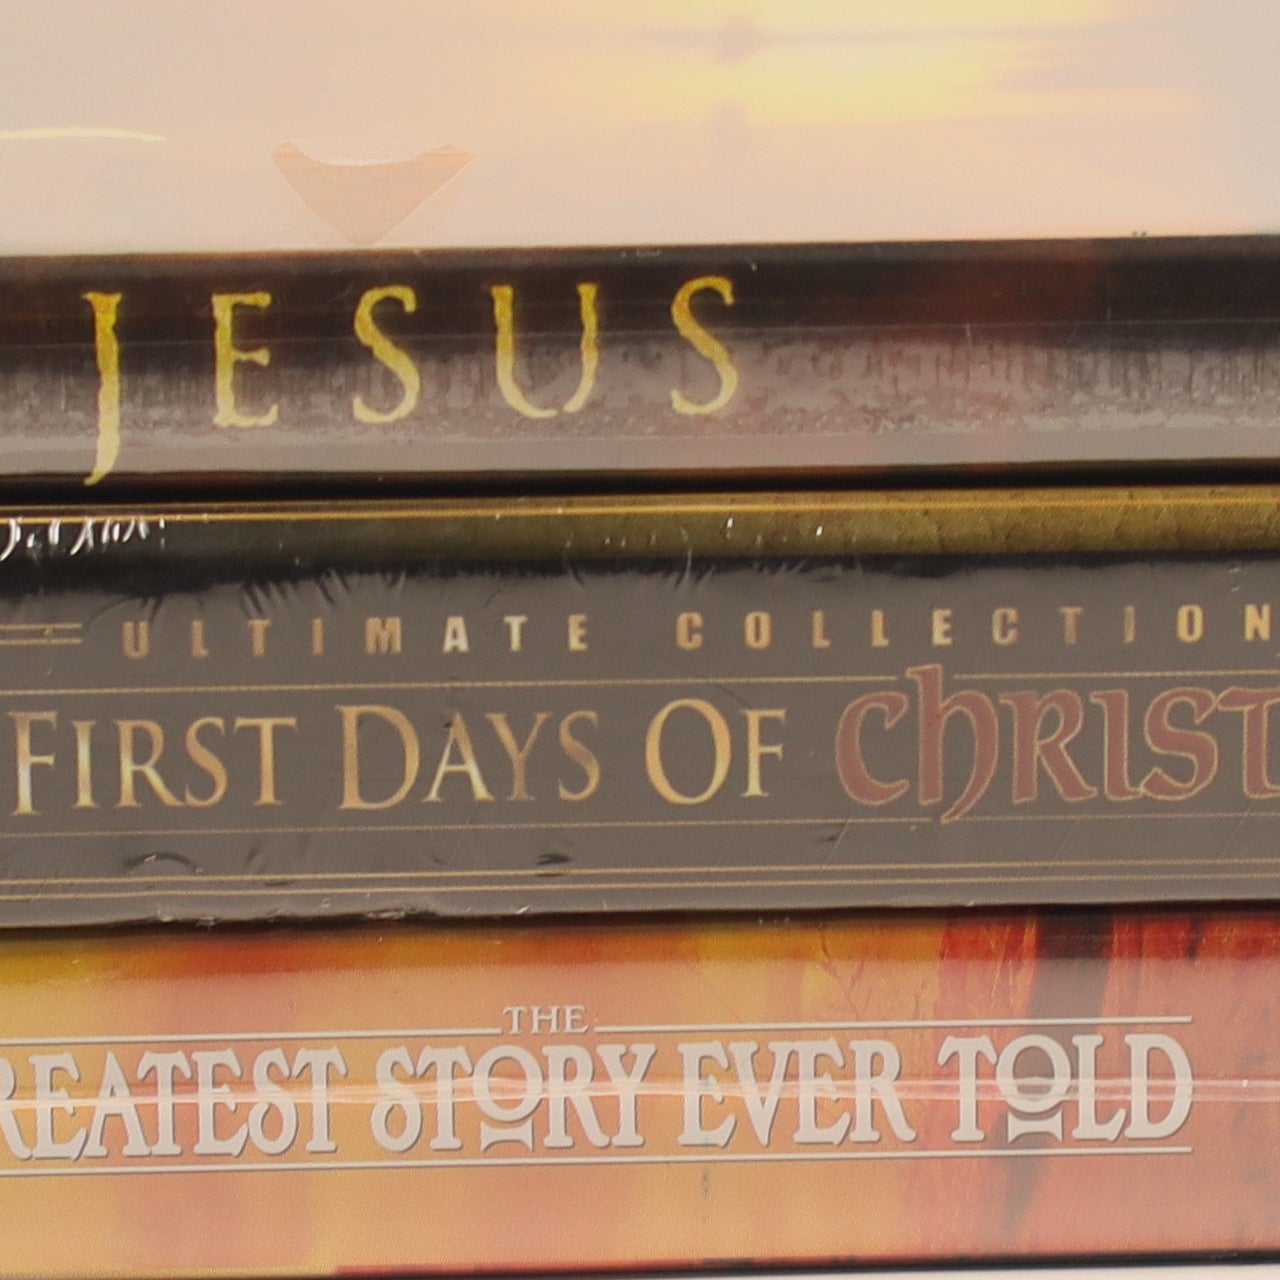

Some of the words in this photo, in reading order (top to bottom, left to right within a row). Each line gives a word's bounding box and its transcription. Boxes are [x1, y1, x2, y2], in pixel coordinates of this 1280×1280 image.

[81, 275, 739, 485] JESUS
[123, 614, 591, 659] ULTIMATE
[7, 709, 300, 817] FIRST
[334, 703, 602, 813] DAYS
[644, 696, 788, 806] OF
[501, 1005, 590, 1035] THE
[371, 1041, 659, 1153] STORY
[676, 1038, 918, 1148] EVER
[938, 1032, 1194, 1145] TOLD
